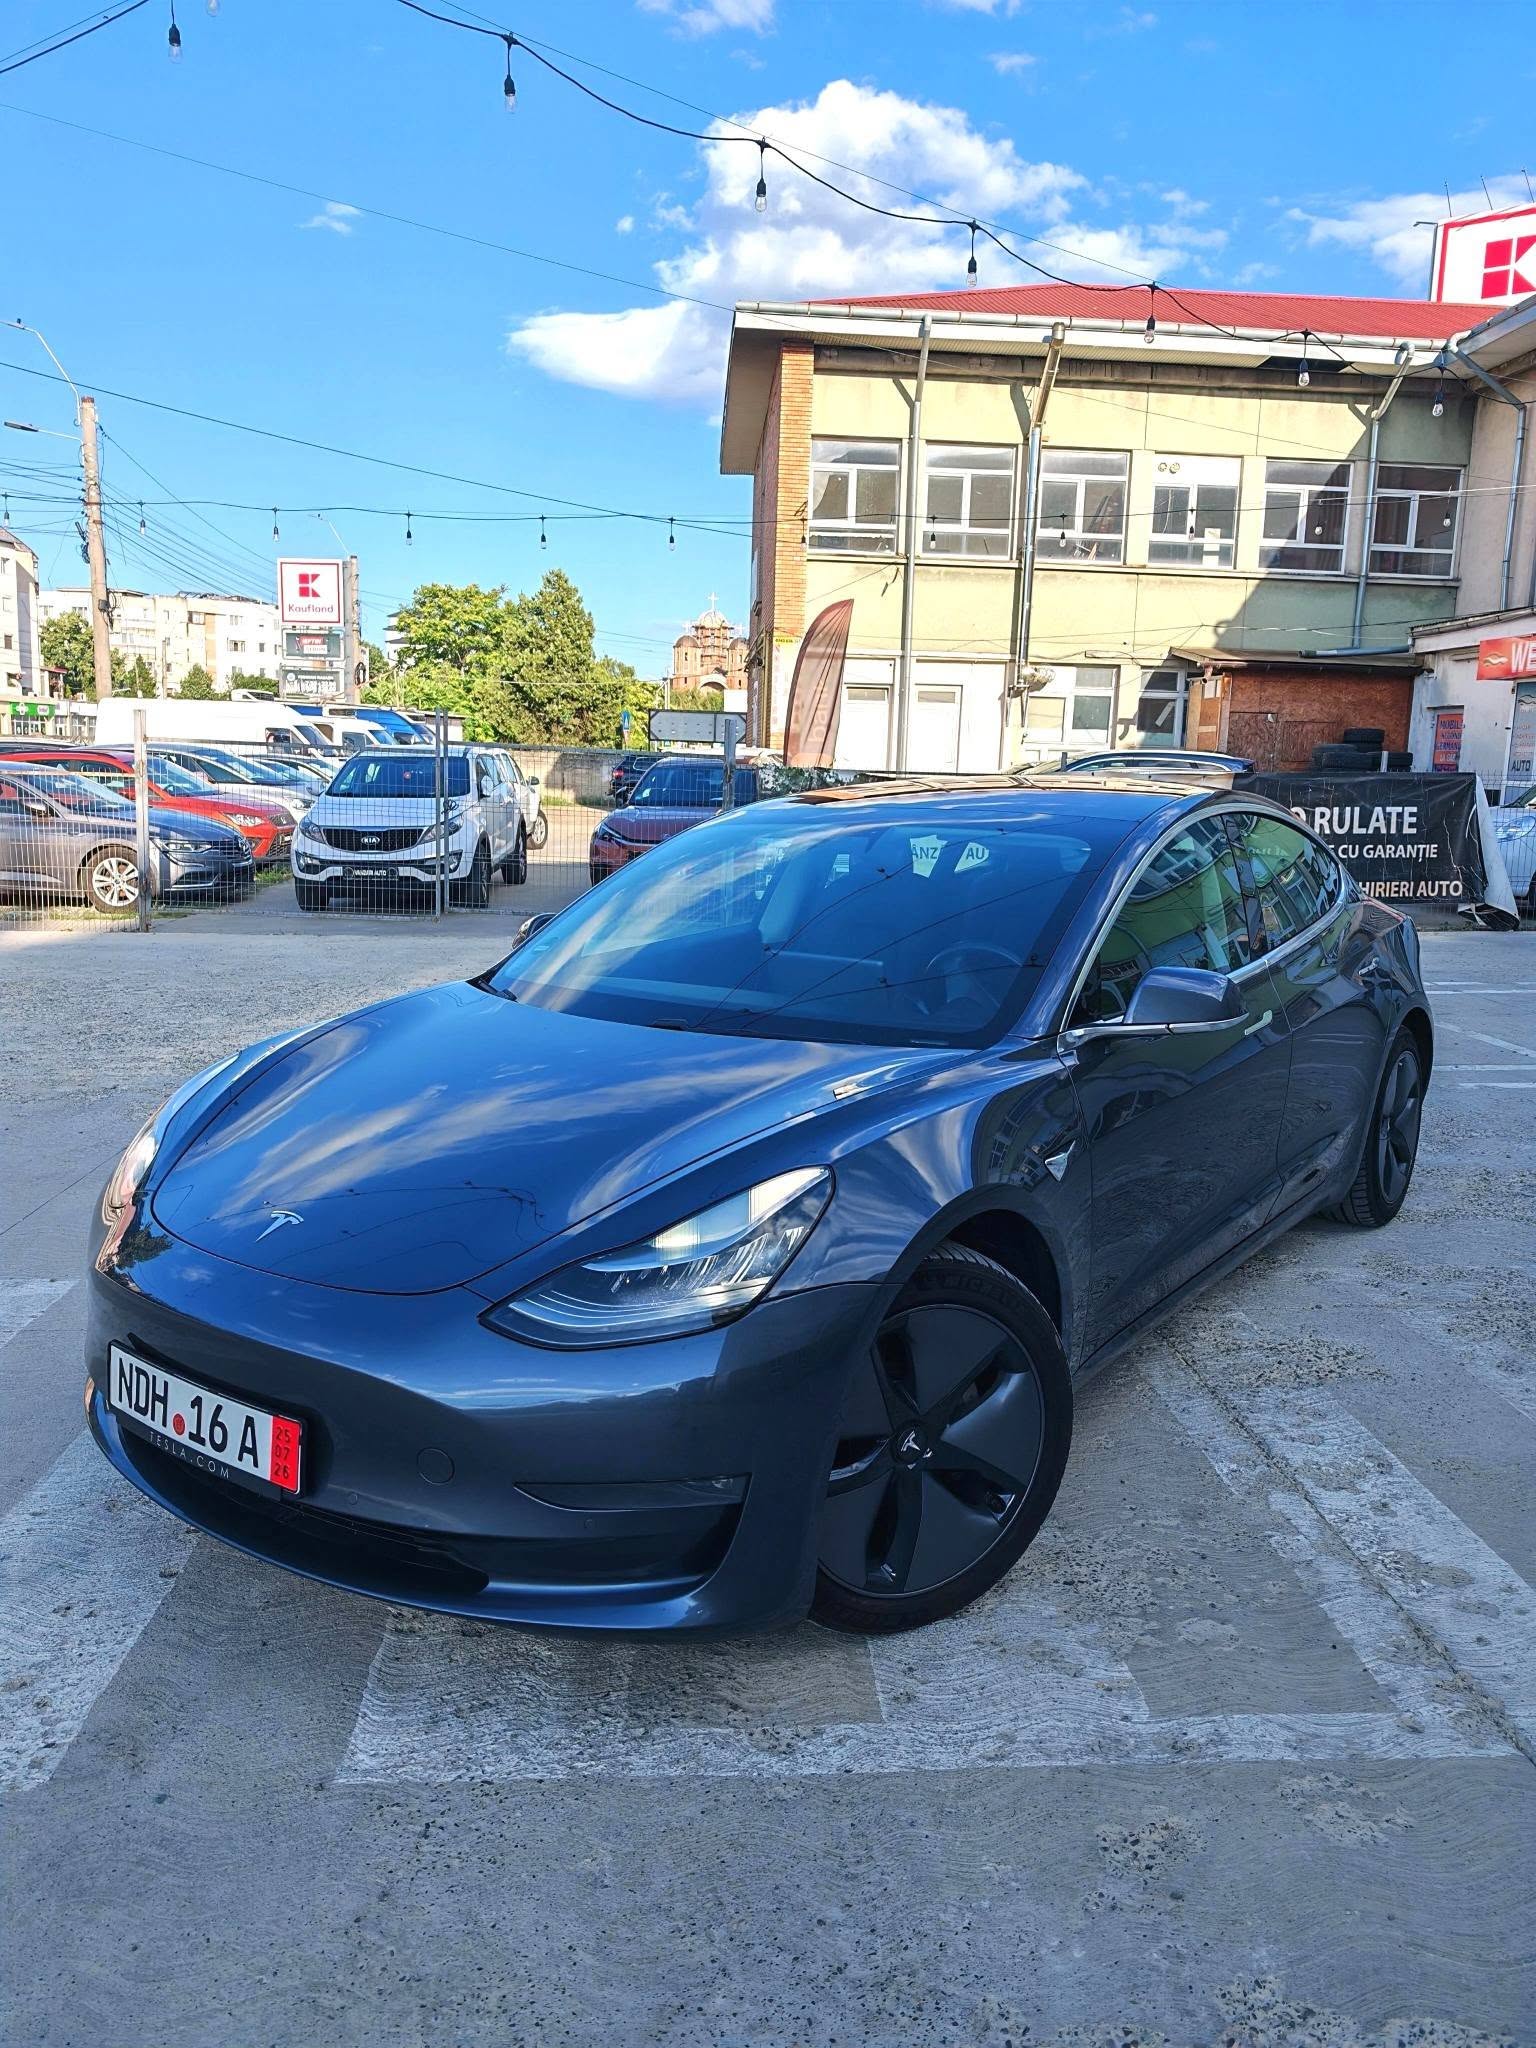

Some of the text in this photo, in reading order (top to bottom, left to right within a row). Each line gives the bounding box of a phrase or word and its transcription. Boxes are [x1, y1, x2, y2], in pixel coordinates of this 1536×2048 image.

[288, 603, 334, 613] Kaufland
[1511, 759, 1531, 772] AUTO
[1314, 806, 1418, 835] RULATE
[966, 847, 985, 860] AU
[1338, 844, 1359, 859] CU
[1363, 843, 1438, 863] GARANȚIE
[373, 868, 387, 876] AUTO
[1359, 880, 1463, 898] HIRIERI AUTO
[119, 1357, 259, 1468] NDH 16 A
[275, 1426, 292, 1443] 25
[149, 1431, 230, 1479] TESLA.COM
[274, 1443, 290, 1462] 07
[273, 1461, 290, 1480] 26
